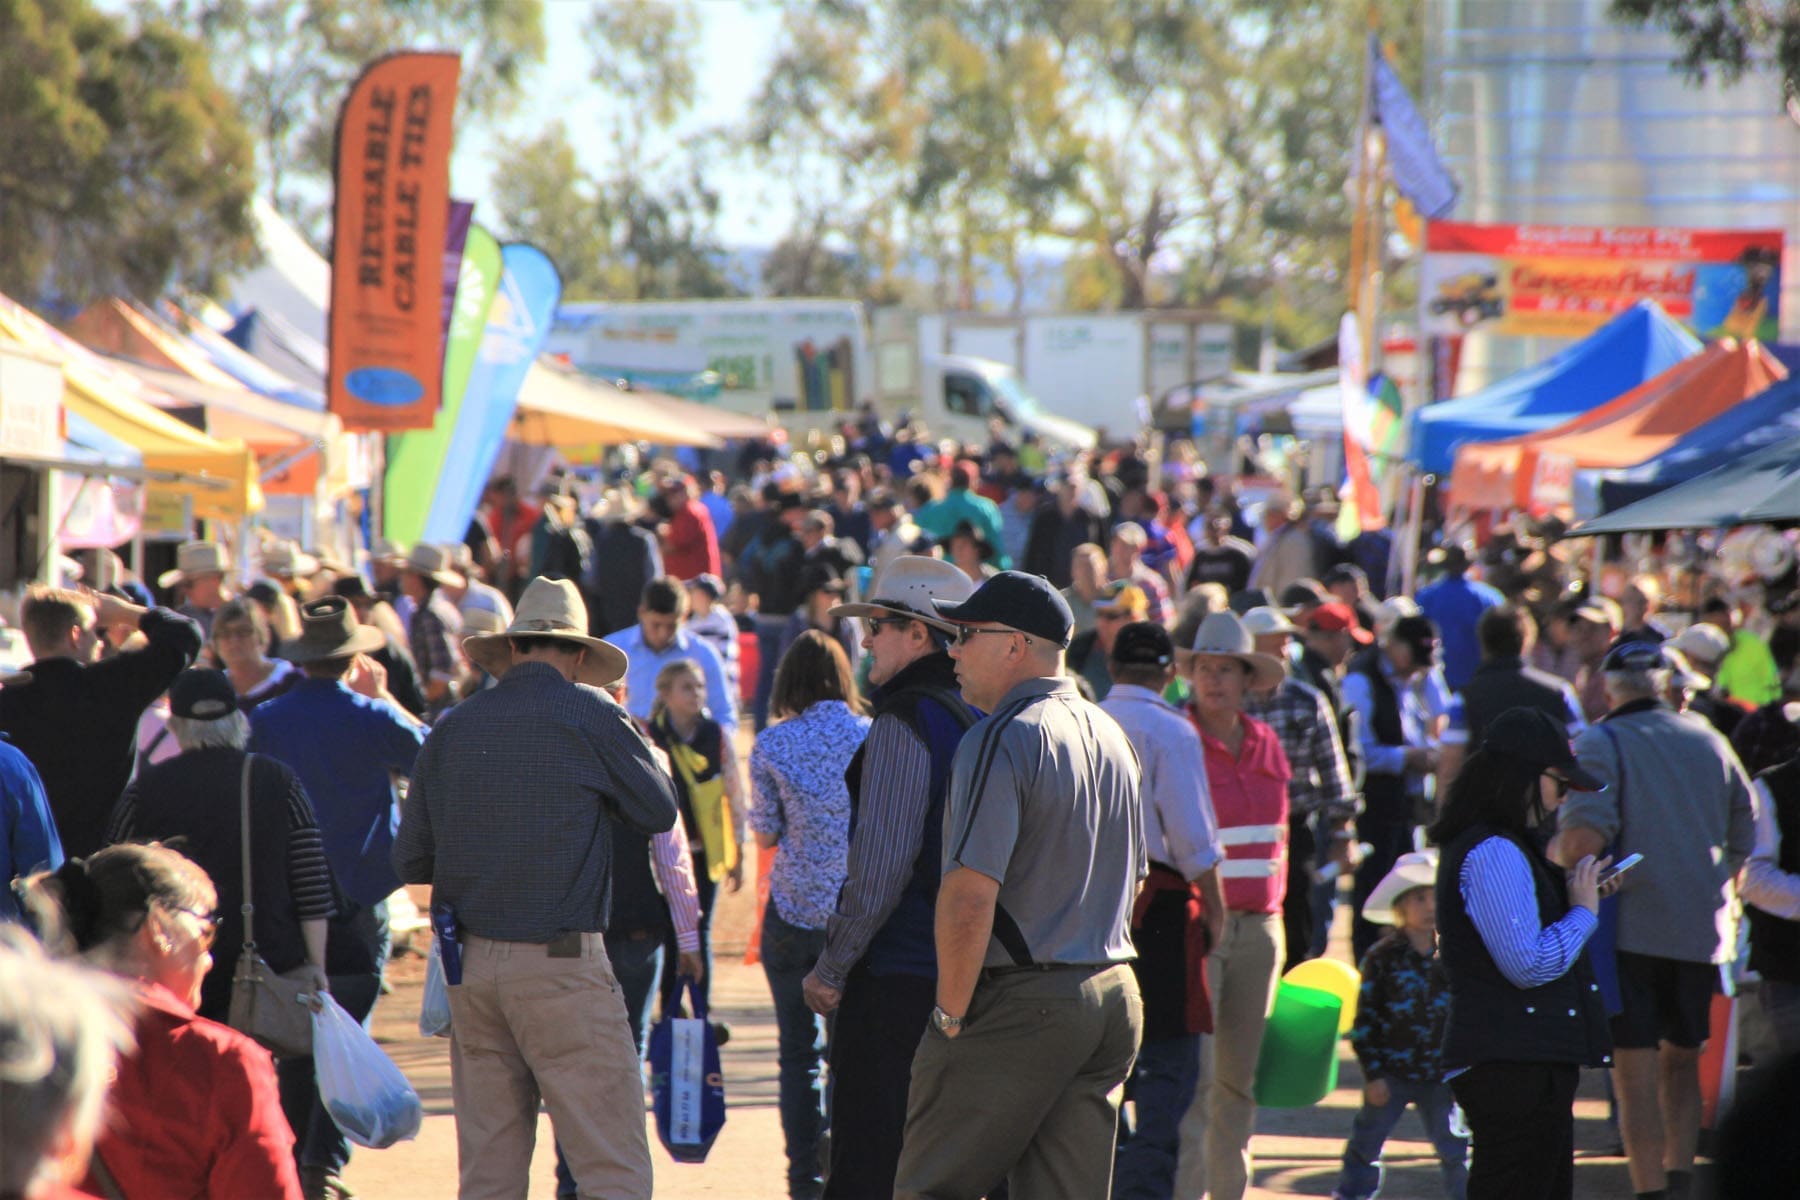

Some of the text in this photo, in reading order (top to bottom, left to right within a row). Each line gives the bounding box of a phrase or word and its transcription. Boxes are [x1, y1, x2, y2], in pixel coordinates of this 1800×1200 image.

[359, 86, 396, 288] REUSABLE
[392, 83, 432, 311] CABLE TIES
[1511, 265, 1696, 298] Greenfield
